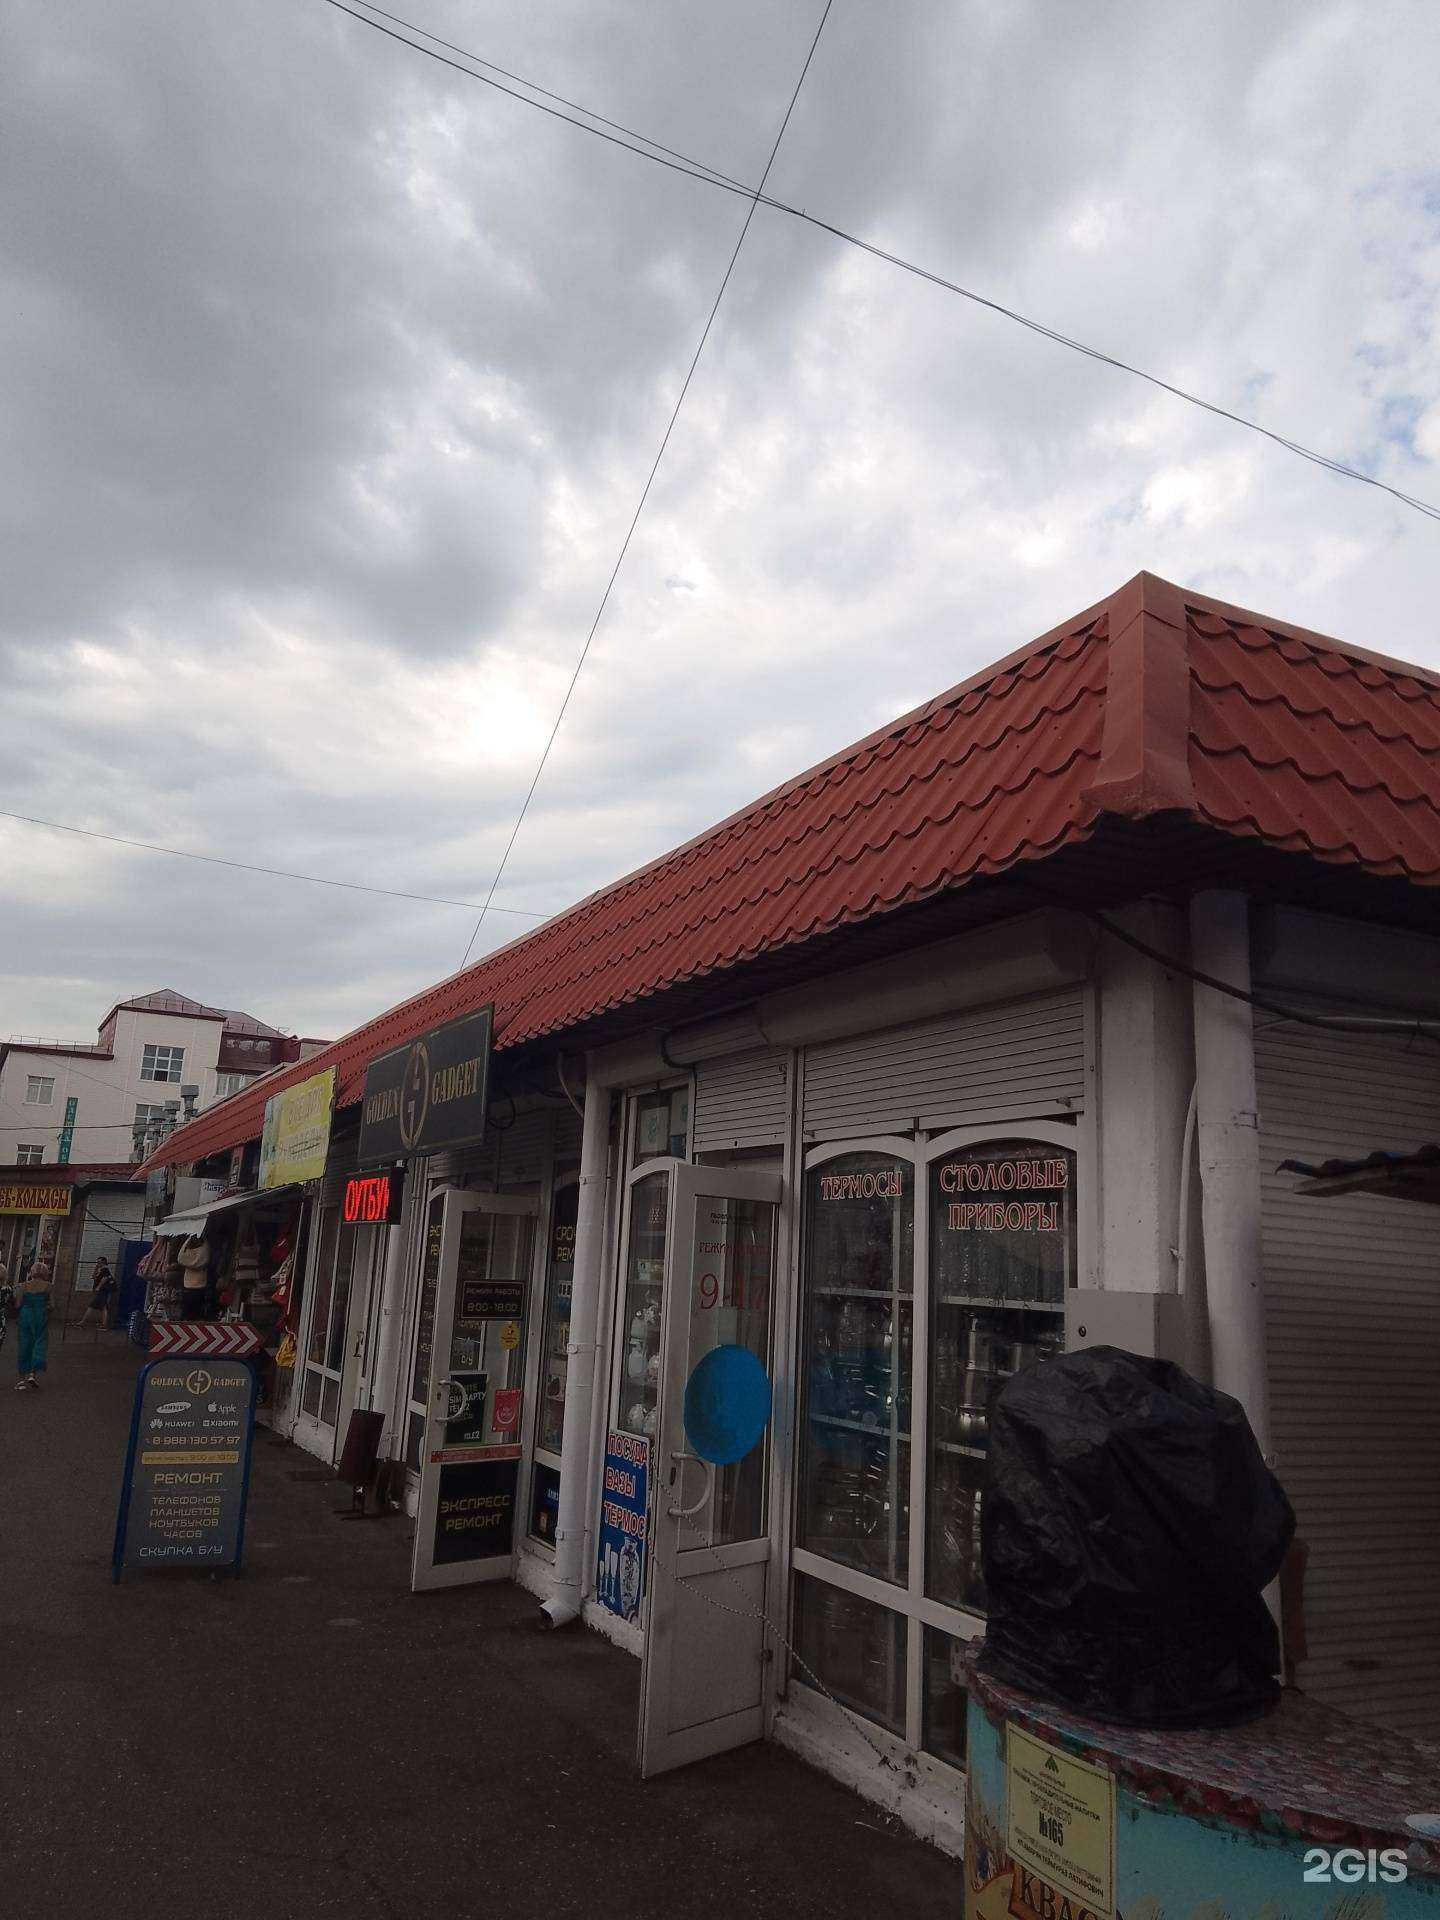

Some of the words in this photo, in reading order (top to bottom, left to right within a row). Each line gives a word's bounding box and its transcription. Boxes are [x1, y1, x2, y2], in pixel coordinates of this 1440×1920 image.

[366, 1087, 400, 1125] GOLDEN
[432, 1057, 480, 1104] GADGET
[939, 1158, 1068, 1193] СТОЛОВЫЕ
[821, 1171, 903, 1201] ТЕРМОСЫ
[948, 1202, 1058, 1231] ПРИБОРЫ
[151, 1377, 184, 1386] GOLDEN
[213, 1377, 247, 1387] GADGET
[607, 1434, 647, 1468] ПОСУДА
[153, 1472, 223, 1485] РЕМОНТ
[605, 1466, 636, 1499] ВАЗЫ
[152, 1496, 221, 1505] ТЕЛЕФОНОВ
[440, 1495, 512, 1513] ЭКСПРЕСС
[150, 1507, 220, 1517] ПЛАНШЕТОВ
[149, 1518, 219, 1528] НОУТБУКОВ
[446, 1513, 503, 1532] РЕМОНТ
[164, 1530, 202, 1539] ЧАСОВ
[139, 1546, 193, 1557] СКУПКА
[199, 1545, 223, 1555] Б/У
[1040, 1811, 1064, 1847] №165
